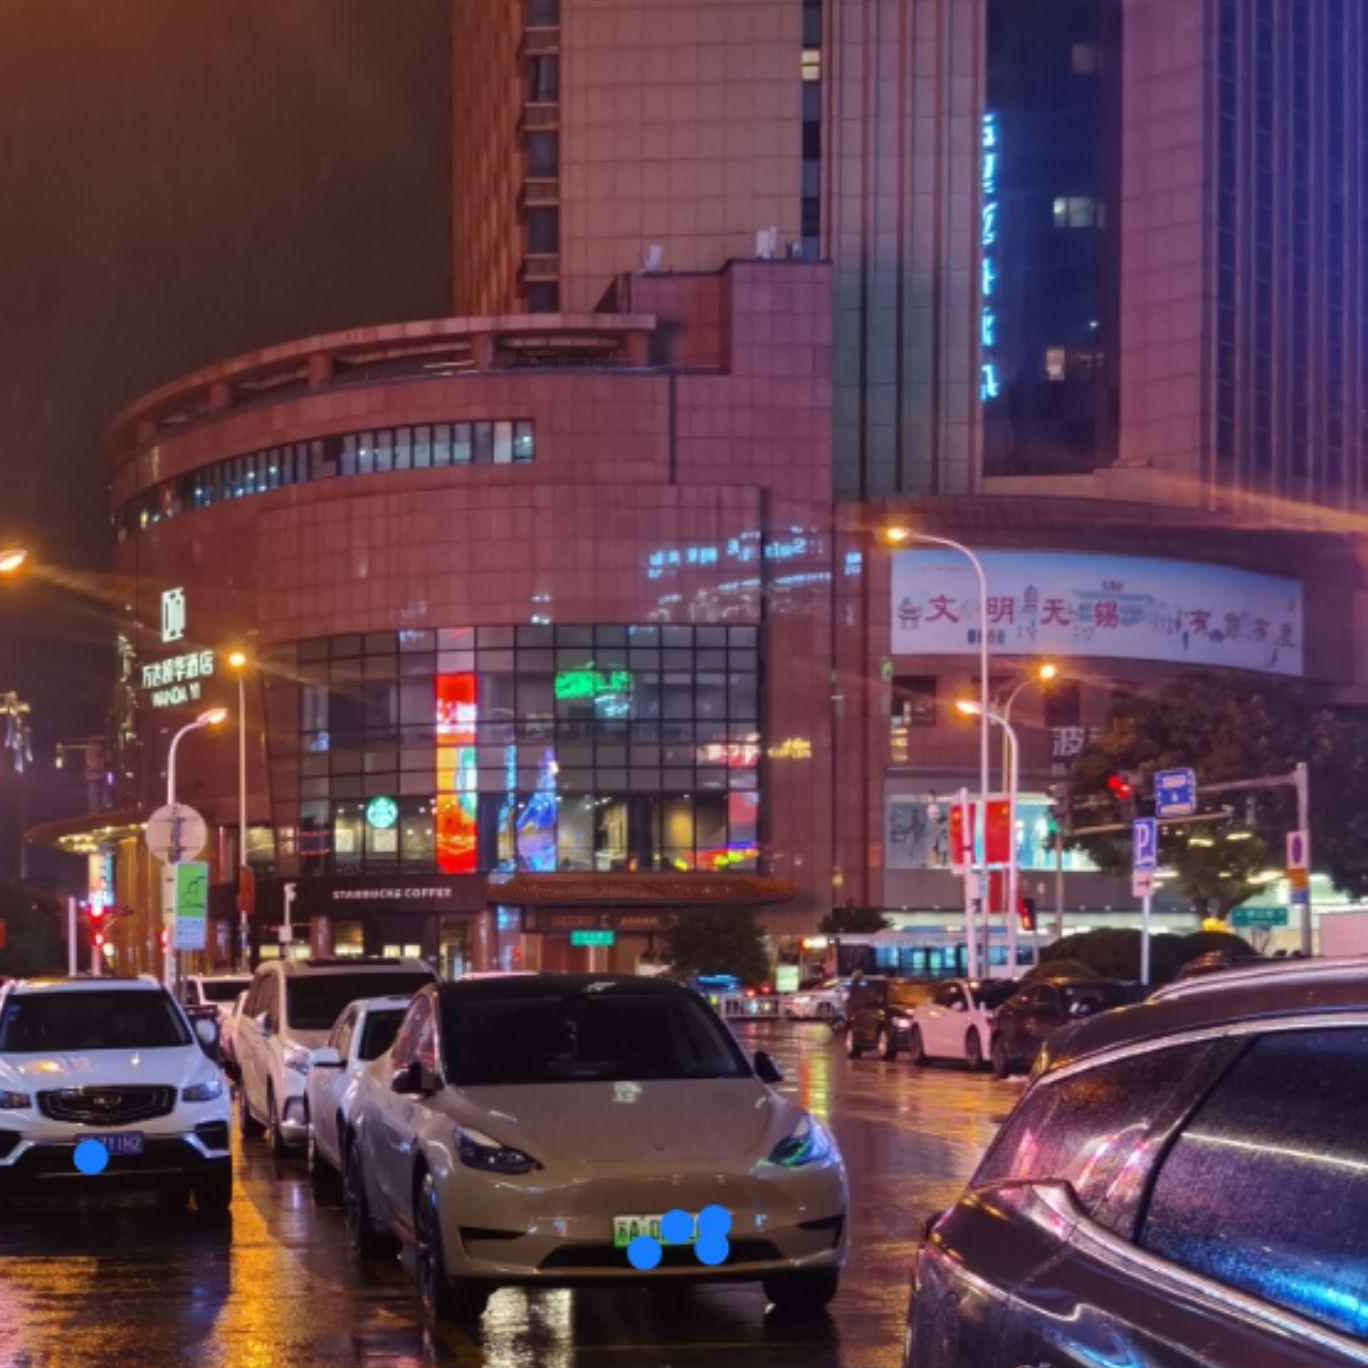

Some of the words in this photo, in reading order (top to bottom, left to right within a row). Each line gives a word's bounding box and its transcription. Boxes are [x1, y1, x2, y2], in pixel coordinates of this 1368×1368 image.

[1135, 824, 1150, 864] P
[333, 888, 401, 900] STARBUCKS
[404, 887, 452, 899] COFFEE
